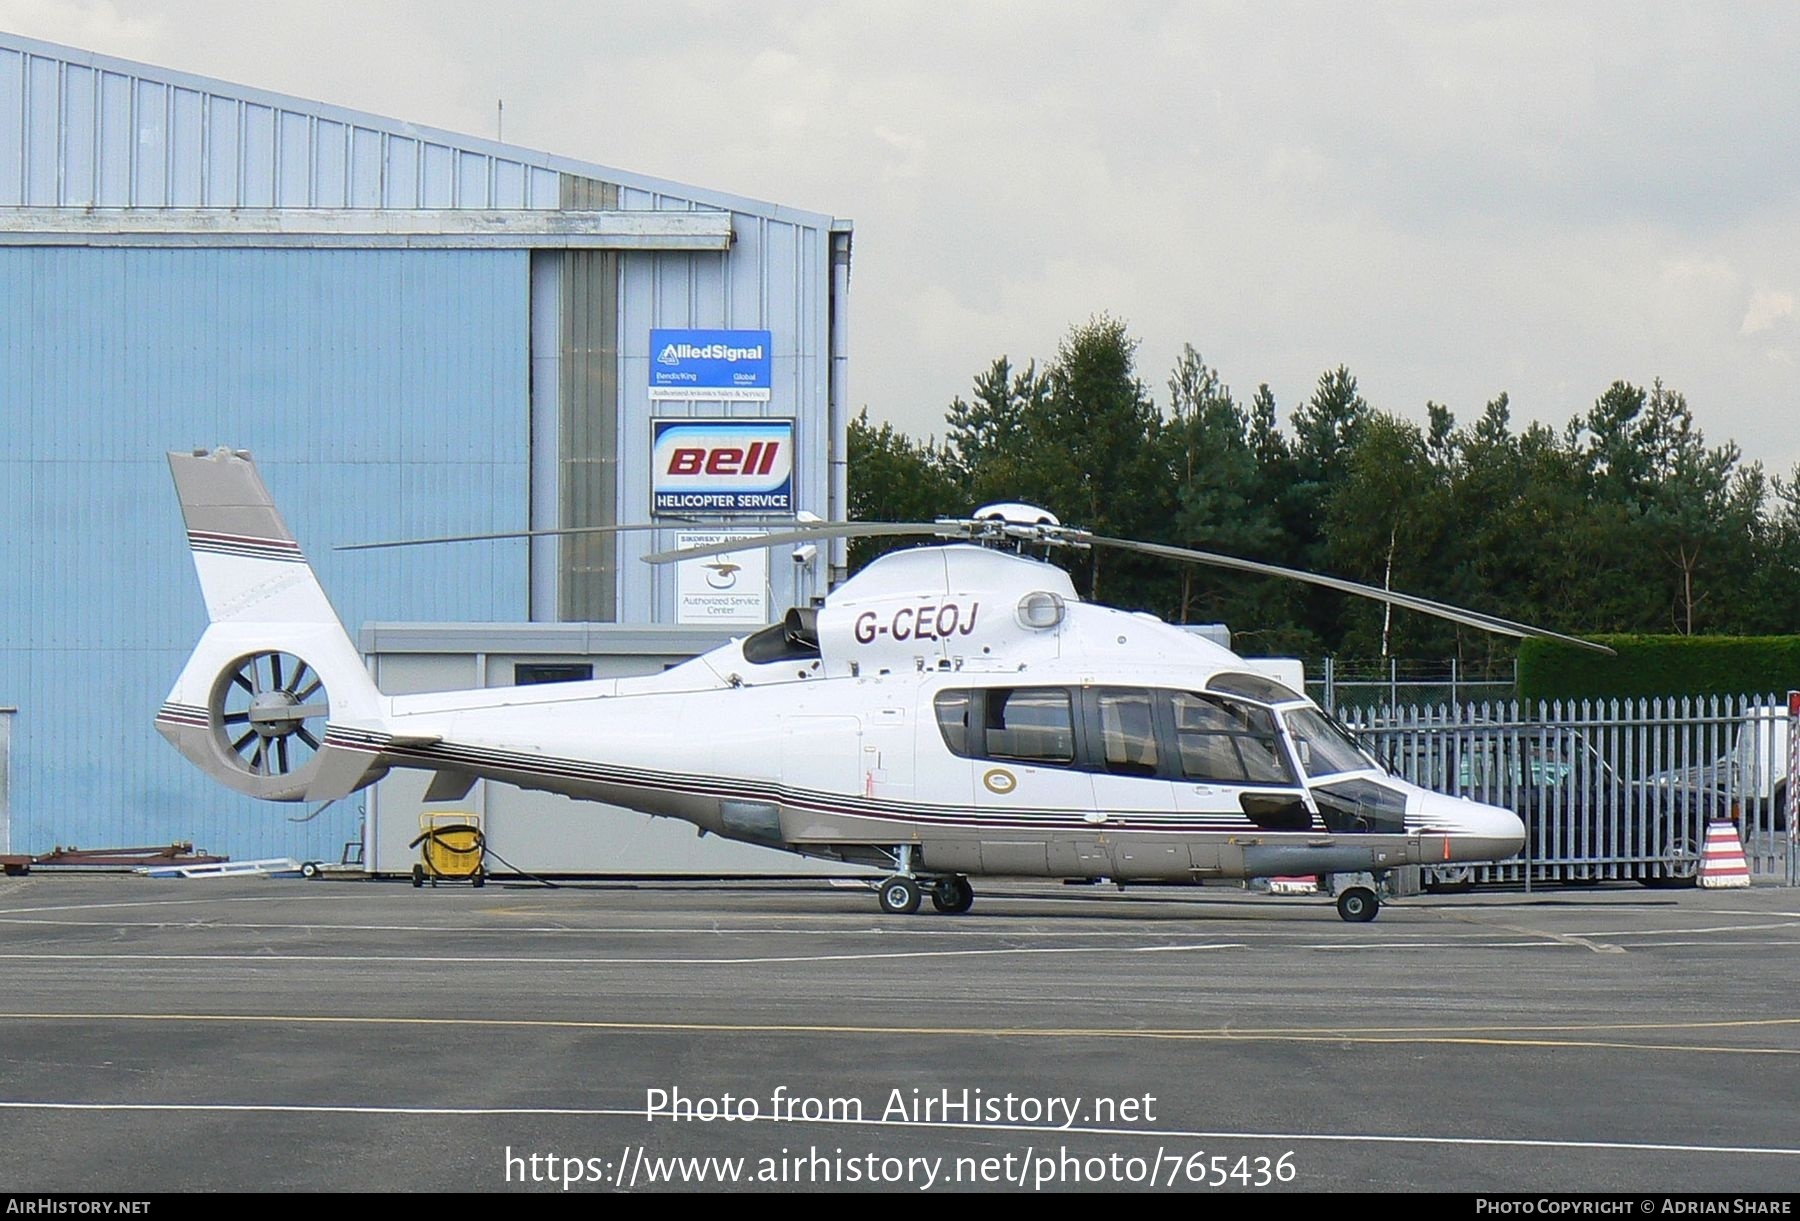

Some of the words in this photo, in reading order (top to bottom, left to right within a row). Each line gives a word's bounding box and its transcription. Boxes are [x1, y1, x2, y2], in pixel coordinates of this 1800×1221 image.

[662, 344, 762, 362] AlliedSignal
[733, 373, 756, 381] Global
[667, 442, 779, 475] Bell
[657, 495, 735, 507] HELICOPTER
[737, 495, 788, 507] SERVICE
[683, 597, 729, 606] Authorized
[730, 597, 760, 606] Service
[707, 606, 735, 615] Center
[855, 602, 979, 644] G-CEOJ
